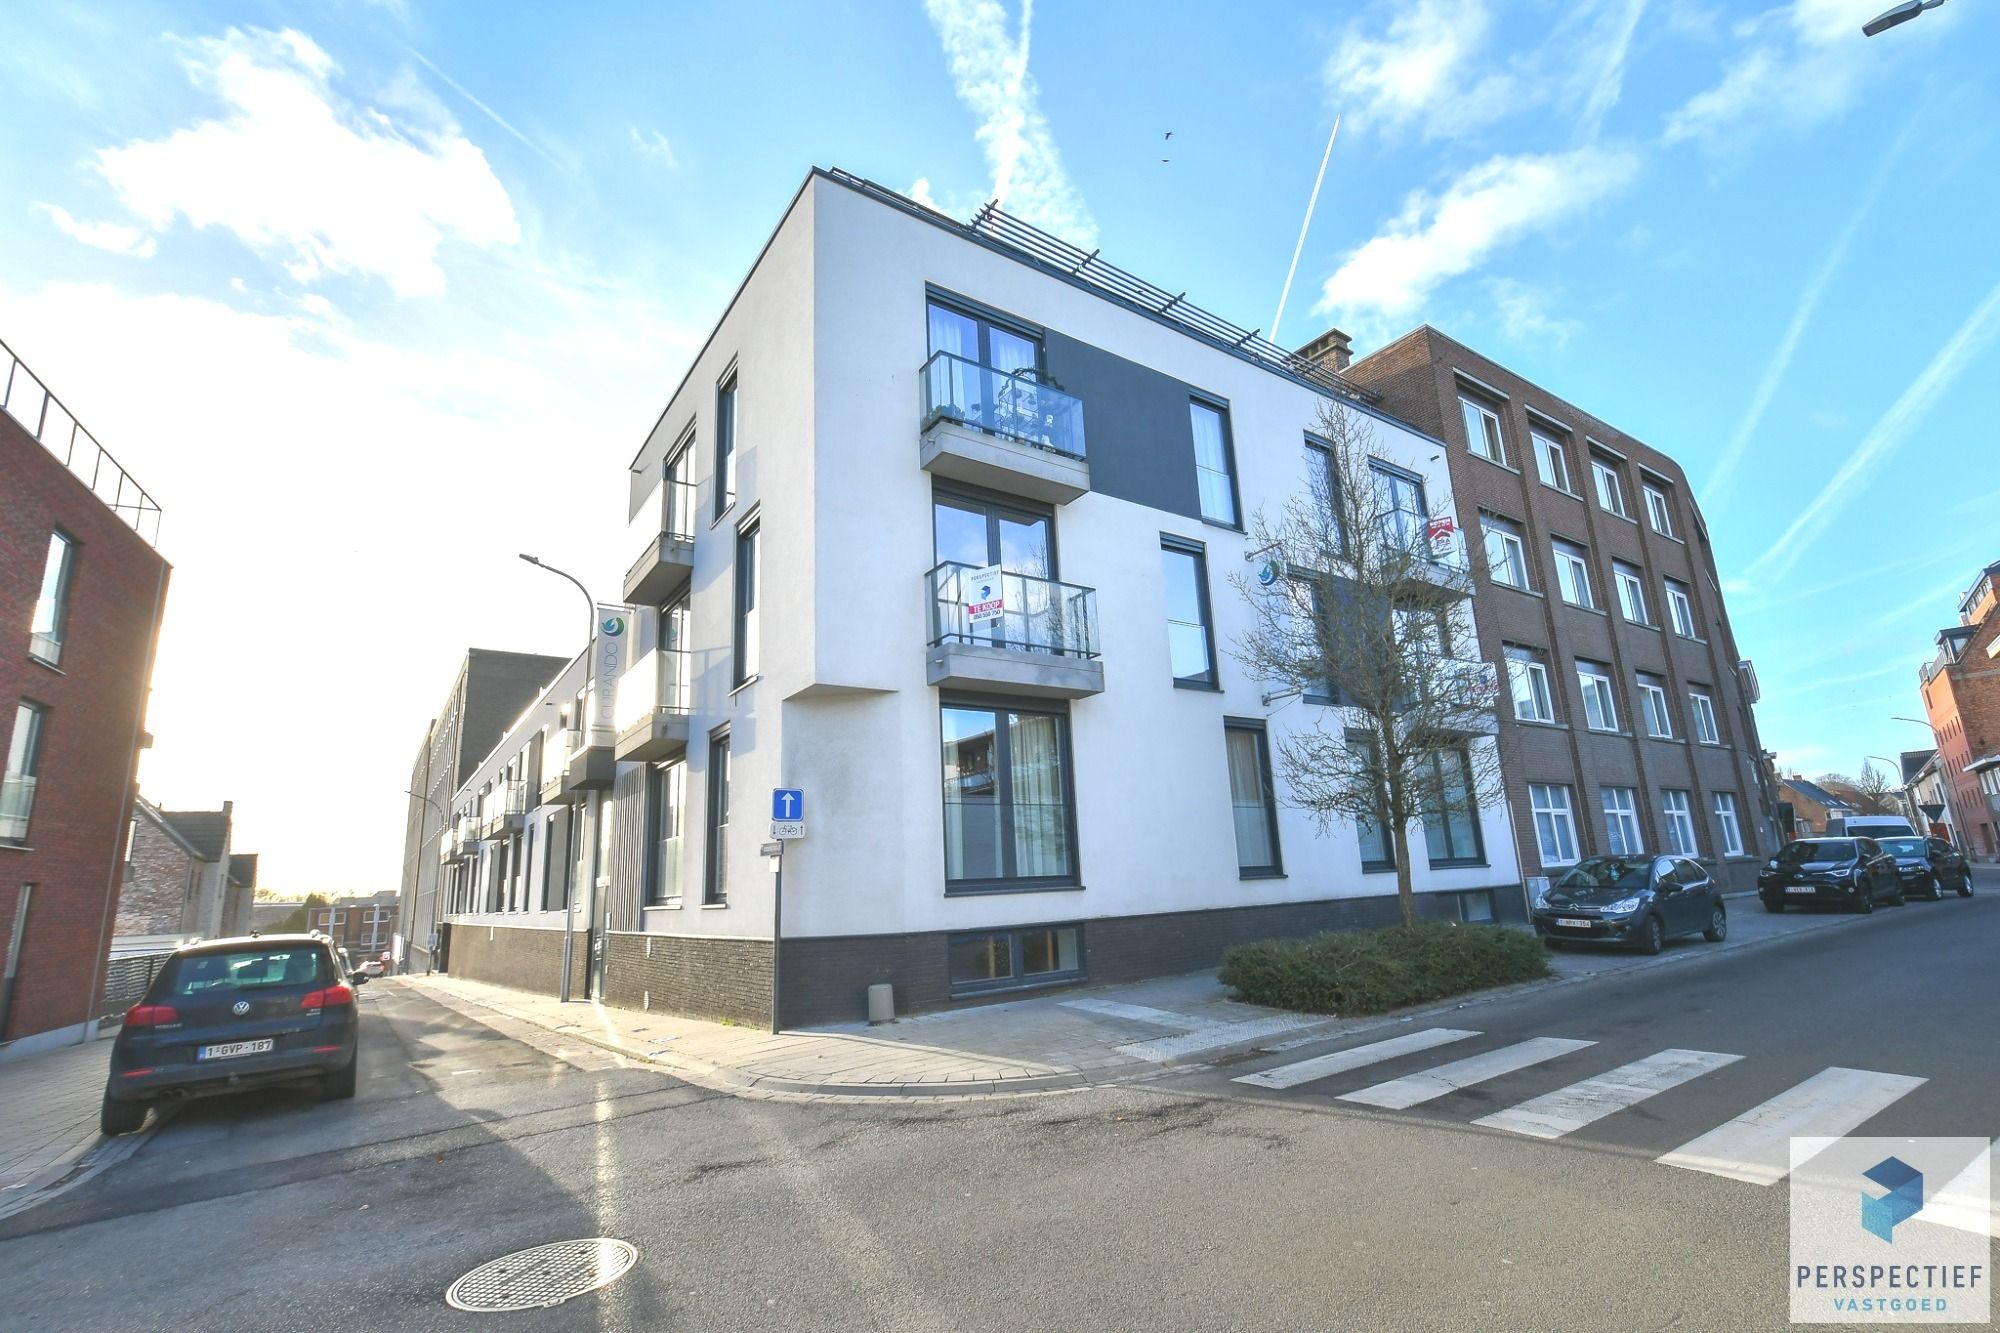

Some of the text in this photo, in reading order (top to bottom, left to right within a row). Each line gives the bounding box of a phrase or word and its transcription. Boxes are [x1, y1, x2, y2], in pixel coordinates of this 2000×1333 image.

[974, 600, 1000, 614] TE KOOP
[601, 642, 618, 720] CURANDO
